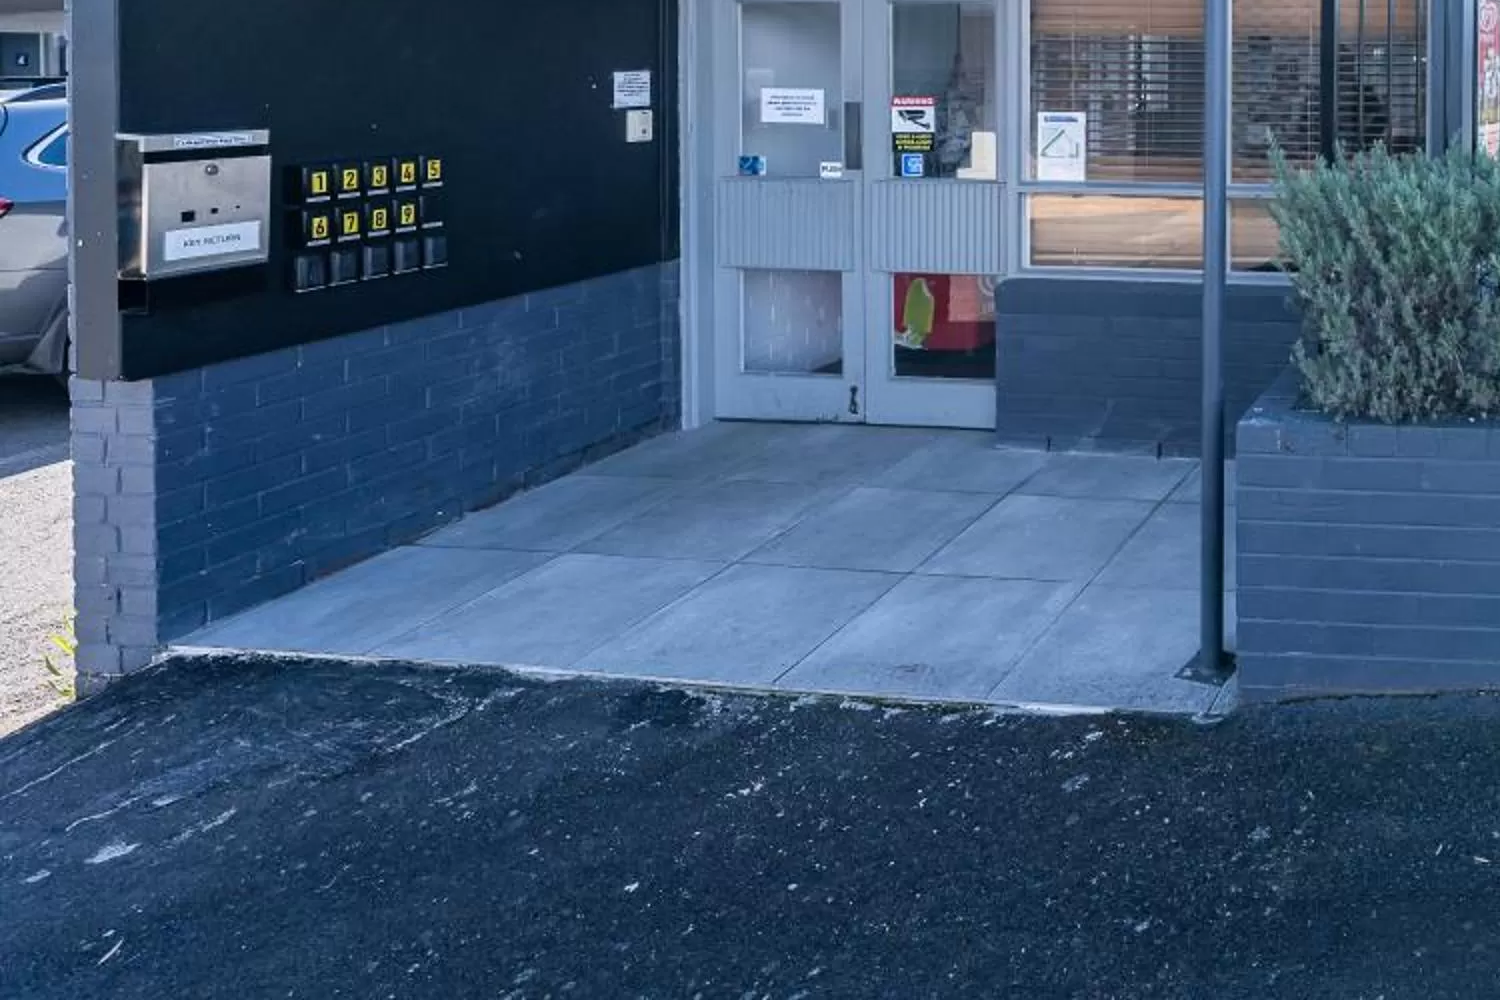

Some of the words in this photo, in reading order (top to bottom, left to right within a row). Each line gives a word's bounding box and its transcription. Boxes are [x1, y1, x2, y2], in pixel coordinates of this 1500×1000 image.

[346, 172, 355, 187] 2
[375, 169, 384, 184] 3
[403, 166, 411, 181] 4
[430, 162, 438, 177] 5
[316, 220, 324, 235] 6
[346, 216, 355, 231] 7
[375, 212, 384, 227] 8
[404, 208, 412, 222] 9
[183, 238, 201, 248] KEY
[203, 234, 241, 245] RETURN
